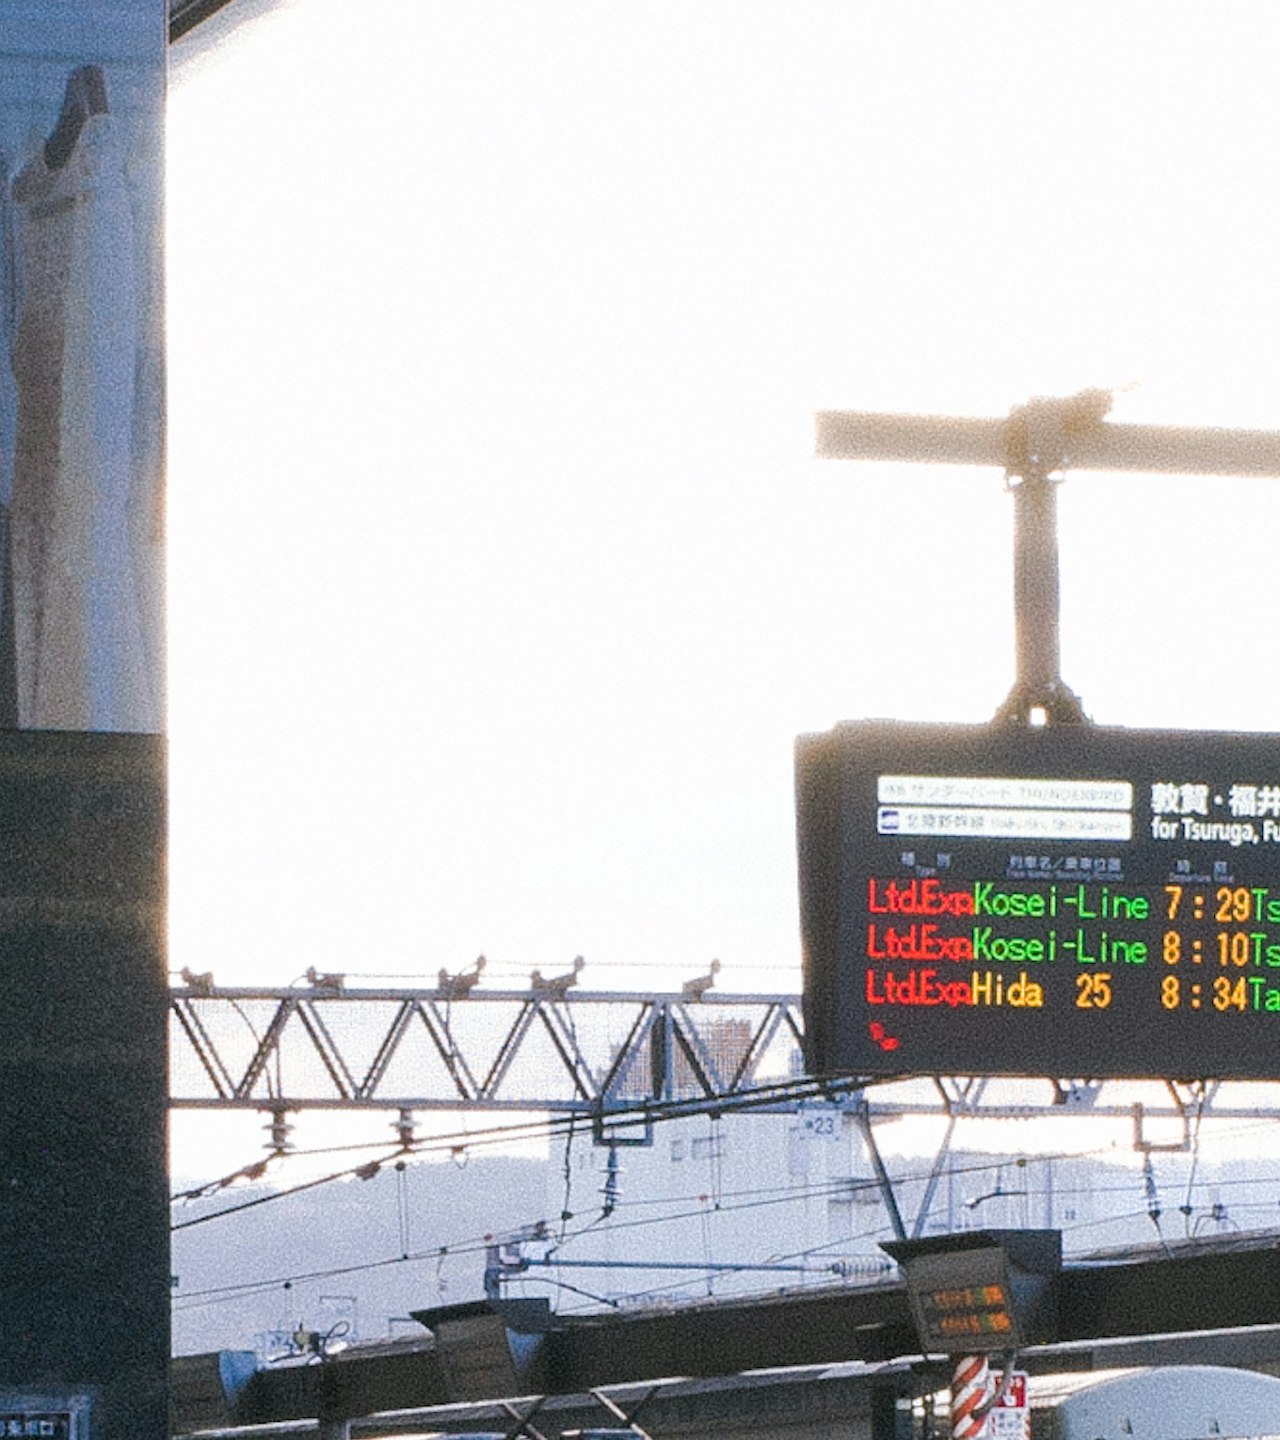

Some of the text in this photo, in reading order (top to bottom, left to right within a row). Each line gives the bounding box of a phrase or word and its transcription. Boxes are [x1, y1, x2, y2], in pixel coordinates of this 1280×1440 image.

[1151, 816, 1179, 839] for
[1181, 817, 1260, 846] Tsuruga,
[975, 881, 1149, 919] Kosei-Line
[973, 926, 1148, 964] Kosei-Line
[972, 970, 1044, 1007] Hida
[1075, 972, 1112, 1008] 25
